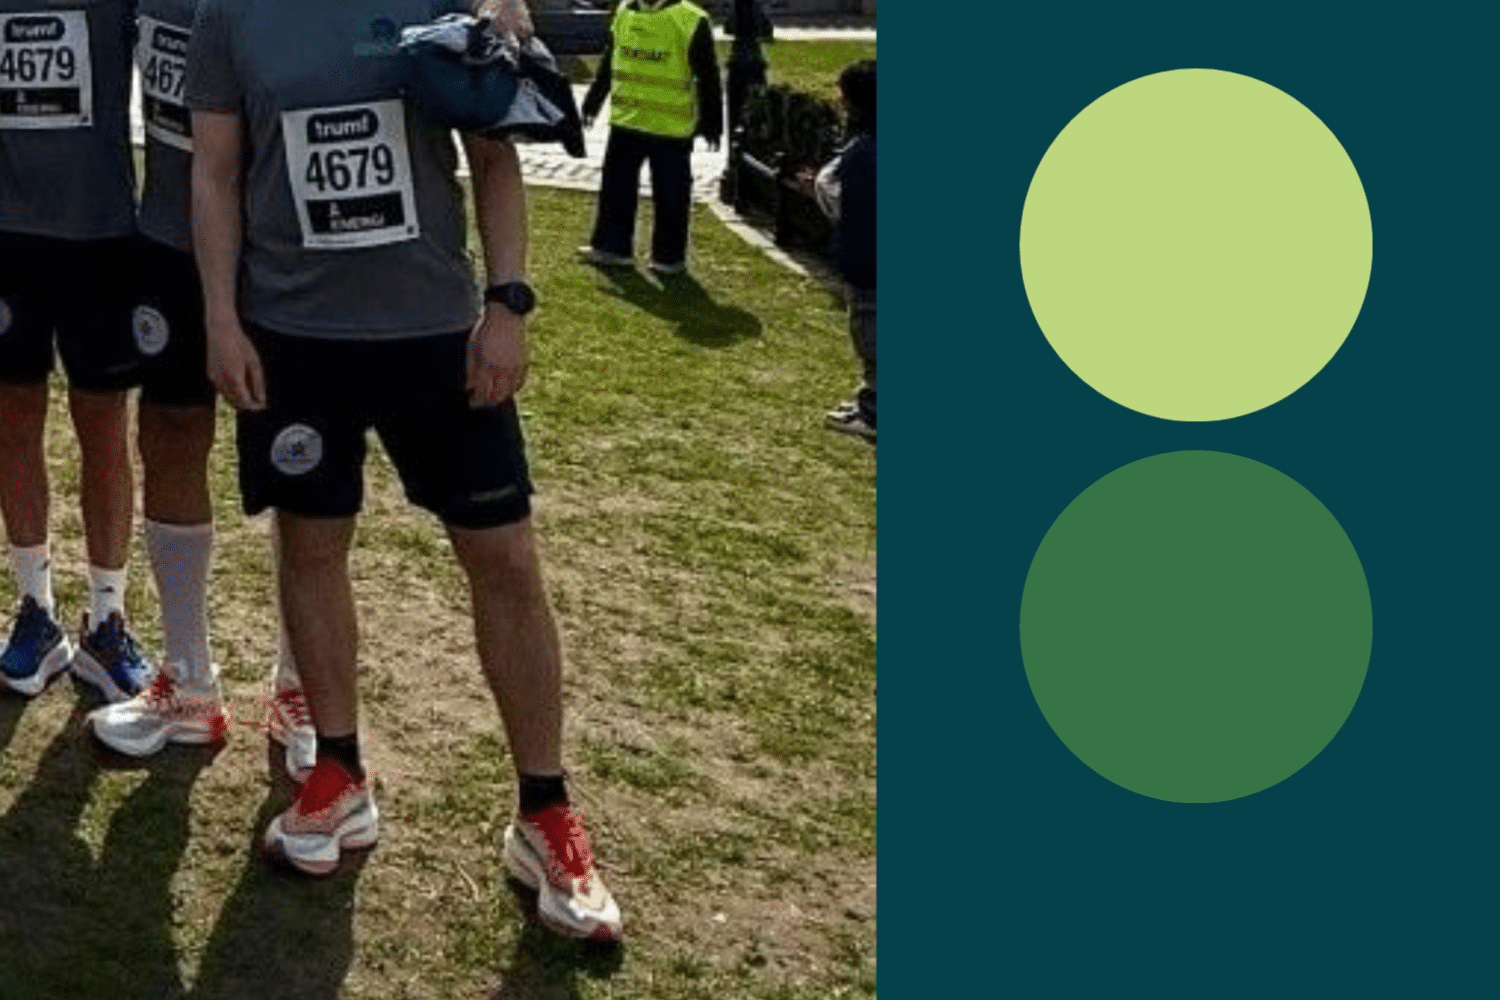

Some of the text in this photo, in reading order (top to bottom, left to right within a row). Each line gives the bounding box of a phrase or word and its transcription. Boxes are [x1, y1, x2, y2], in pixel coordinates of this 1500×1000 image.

[0, 46, 76, 82] 4679
[143, 55, 186, 97] 467
[306, 144, 394, 192] 4679
